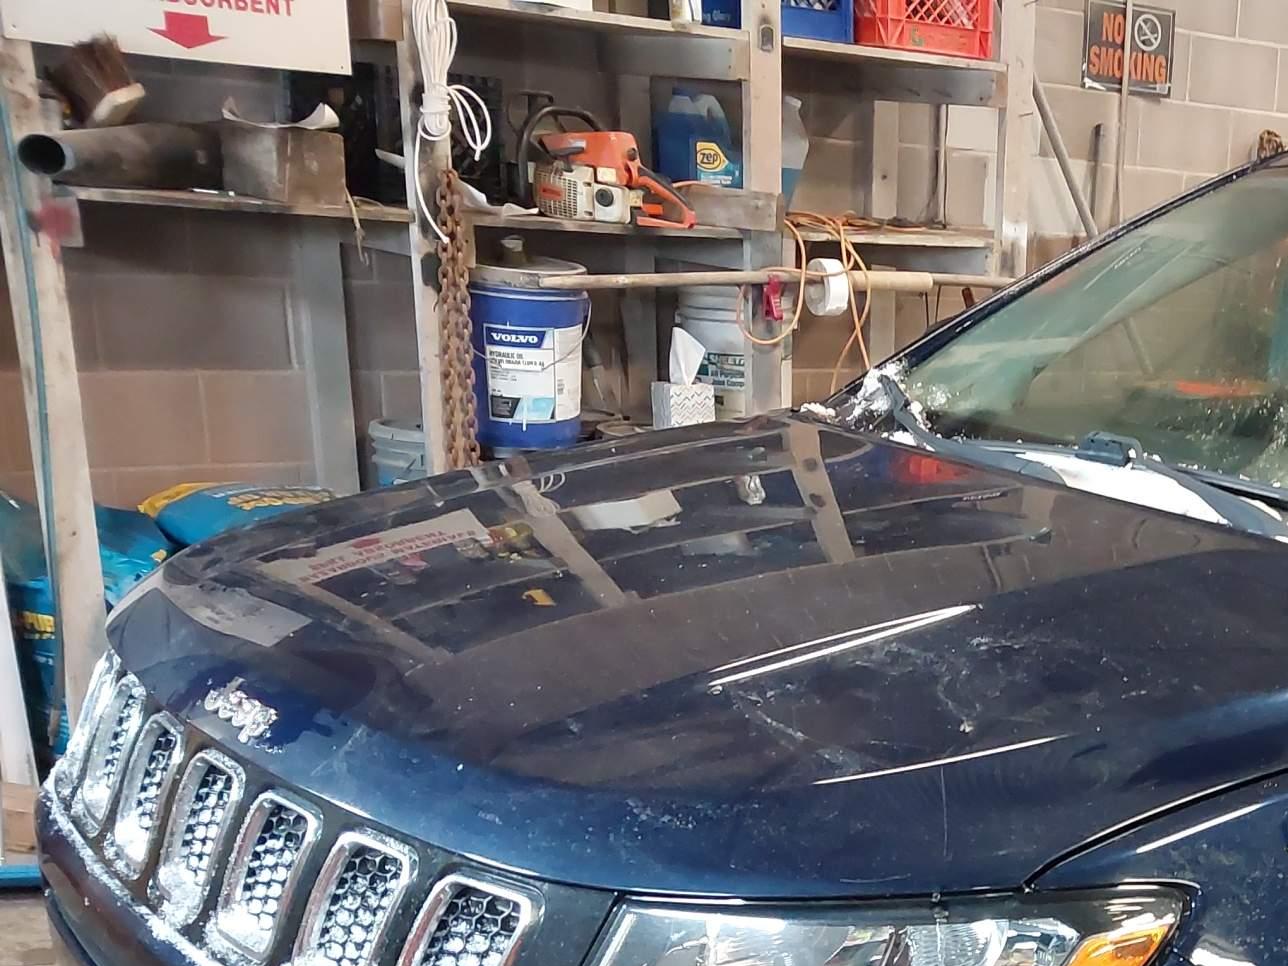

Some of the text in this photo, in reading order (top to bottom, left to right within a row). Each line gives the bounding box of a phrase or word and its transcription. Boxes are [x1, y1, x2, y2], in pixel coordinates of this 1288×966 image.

[1102, 11, 1125, 44] NO
[1088, 45, 1167, 84] SMOKING
[491, 332, 538, 344] VOLVO
